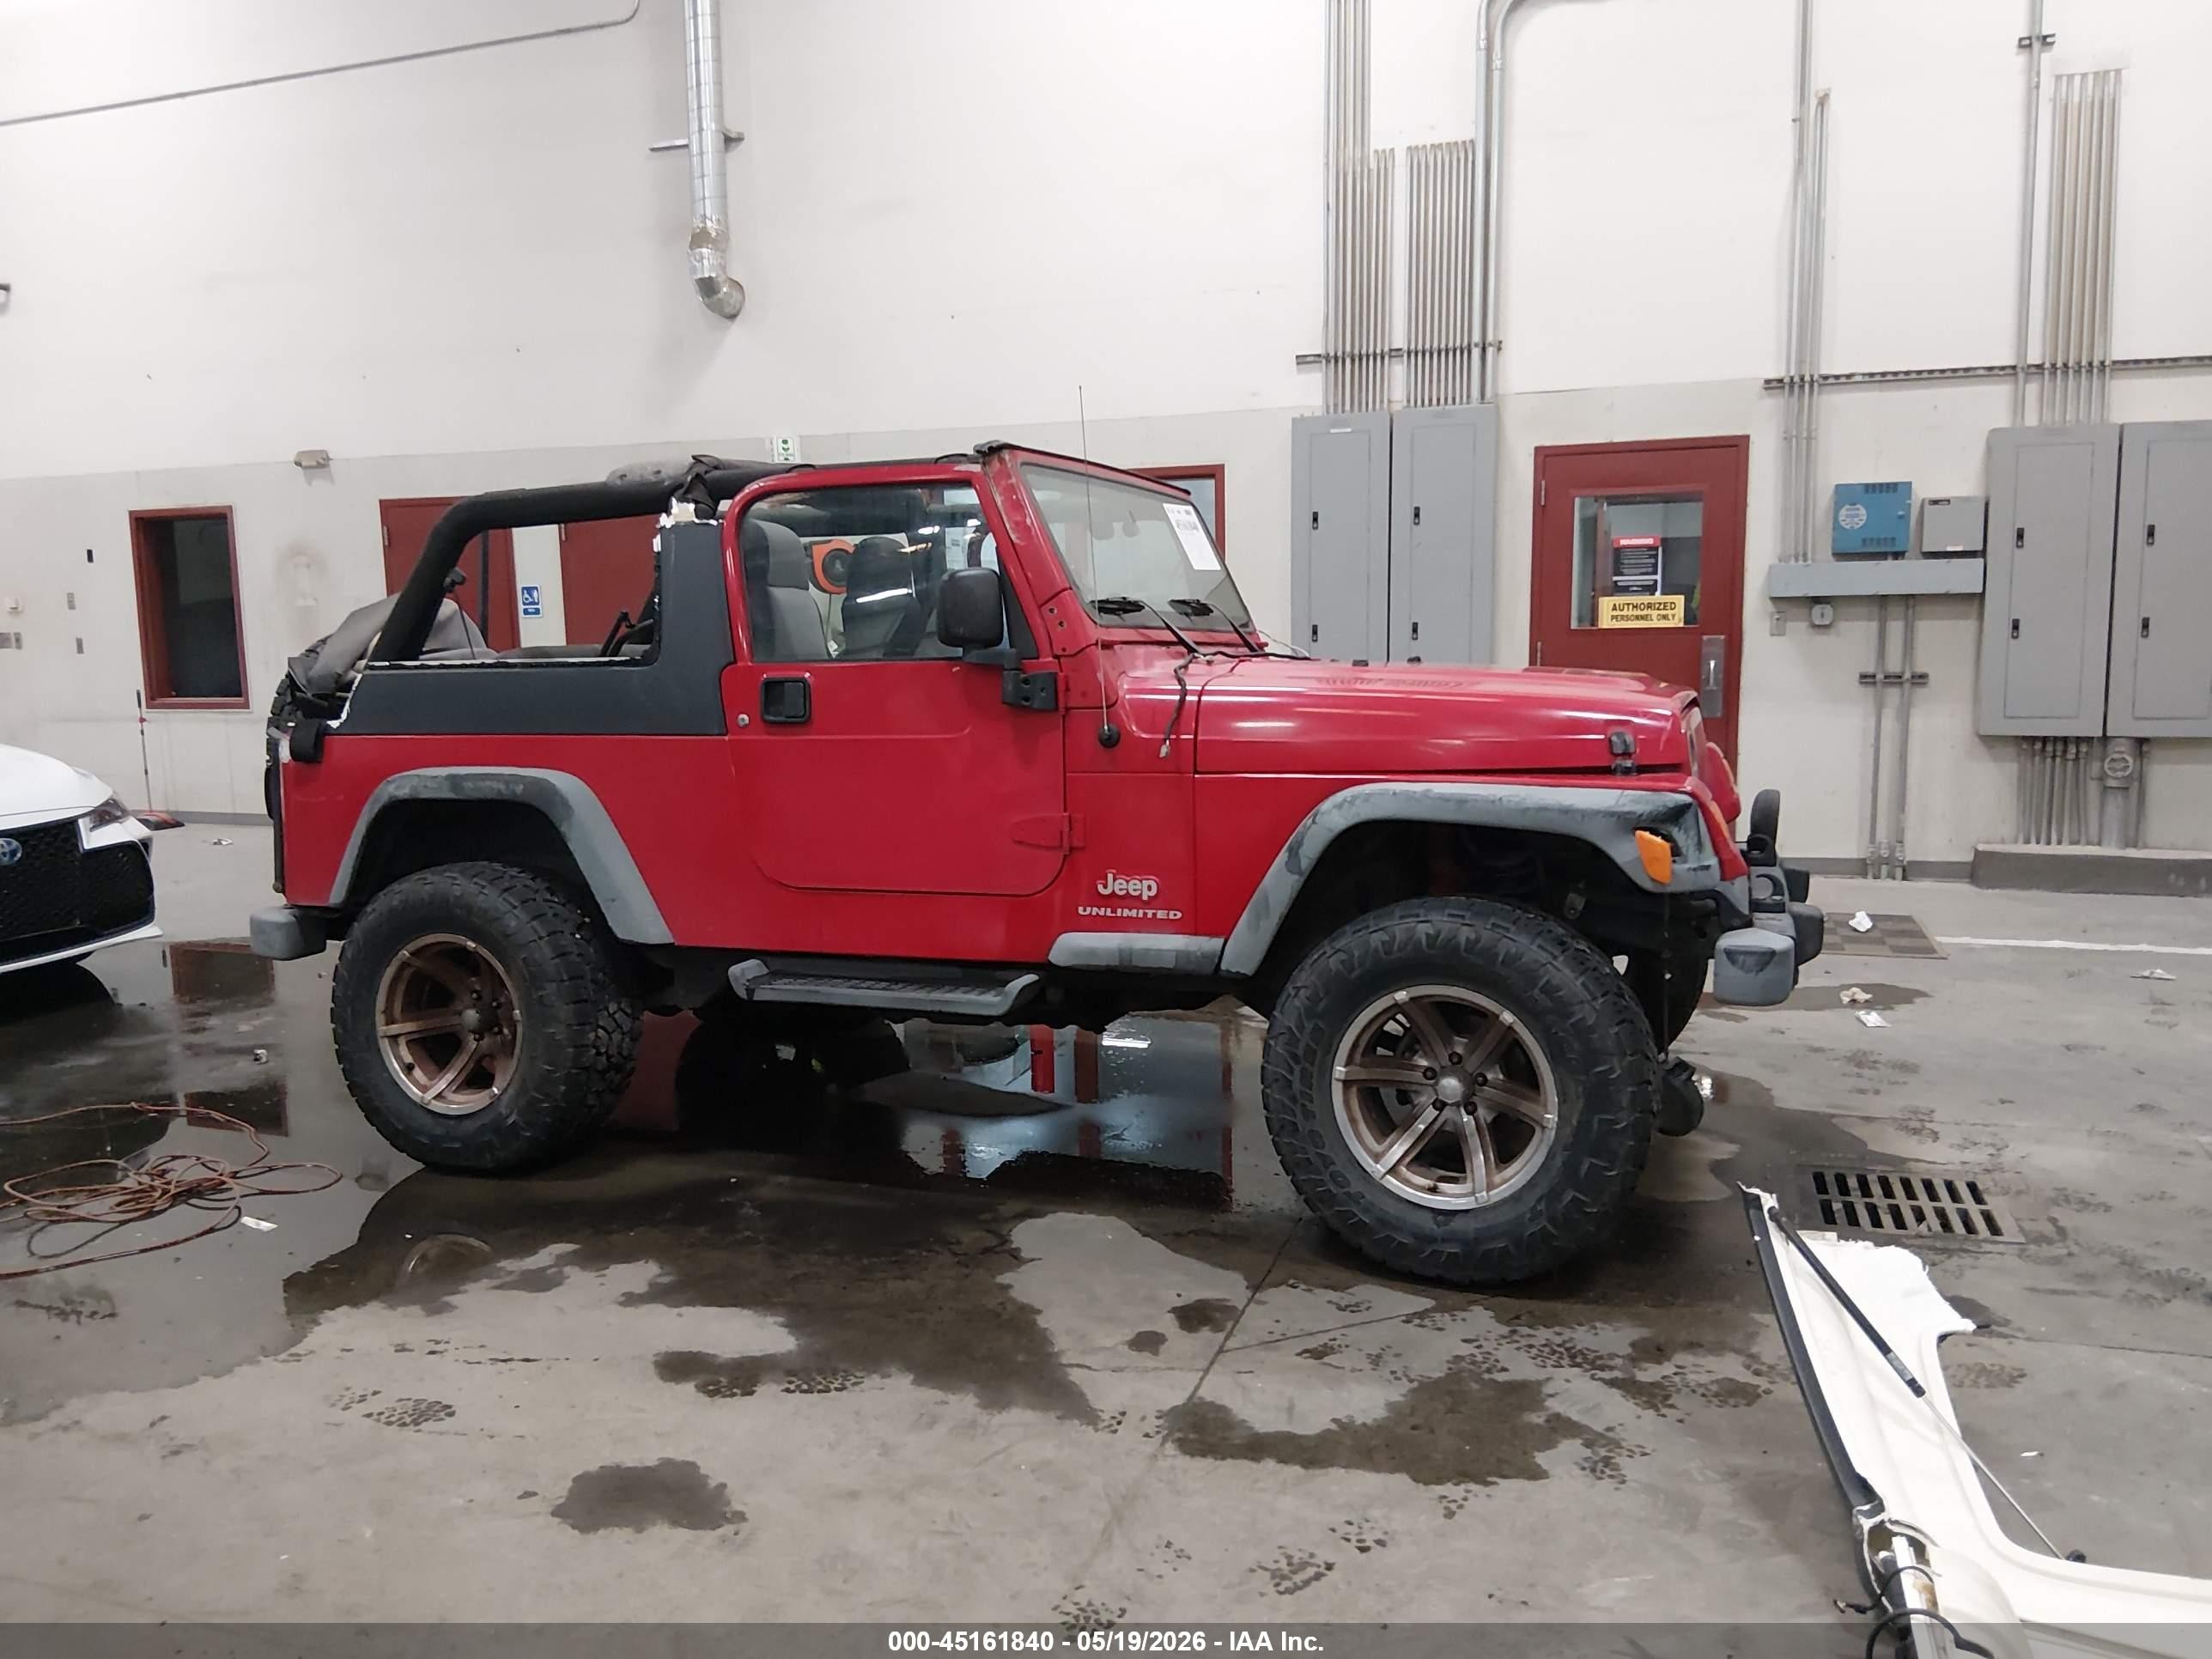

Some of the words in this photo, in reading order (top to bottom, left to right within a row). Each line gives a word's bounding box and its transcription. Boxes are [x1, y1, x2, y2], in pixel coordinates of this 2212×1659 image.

[1611, 601, 1677, 612] AUTHORIZED
[1610, 613, 1654, 623] PERSONNEL
[1656, 612, 1677, 622] ONLY
[1097, 870, 1159, 901] Jeep
[1078, 906, 1182, 920] UNLIMITED
